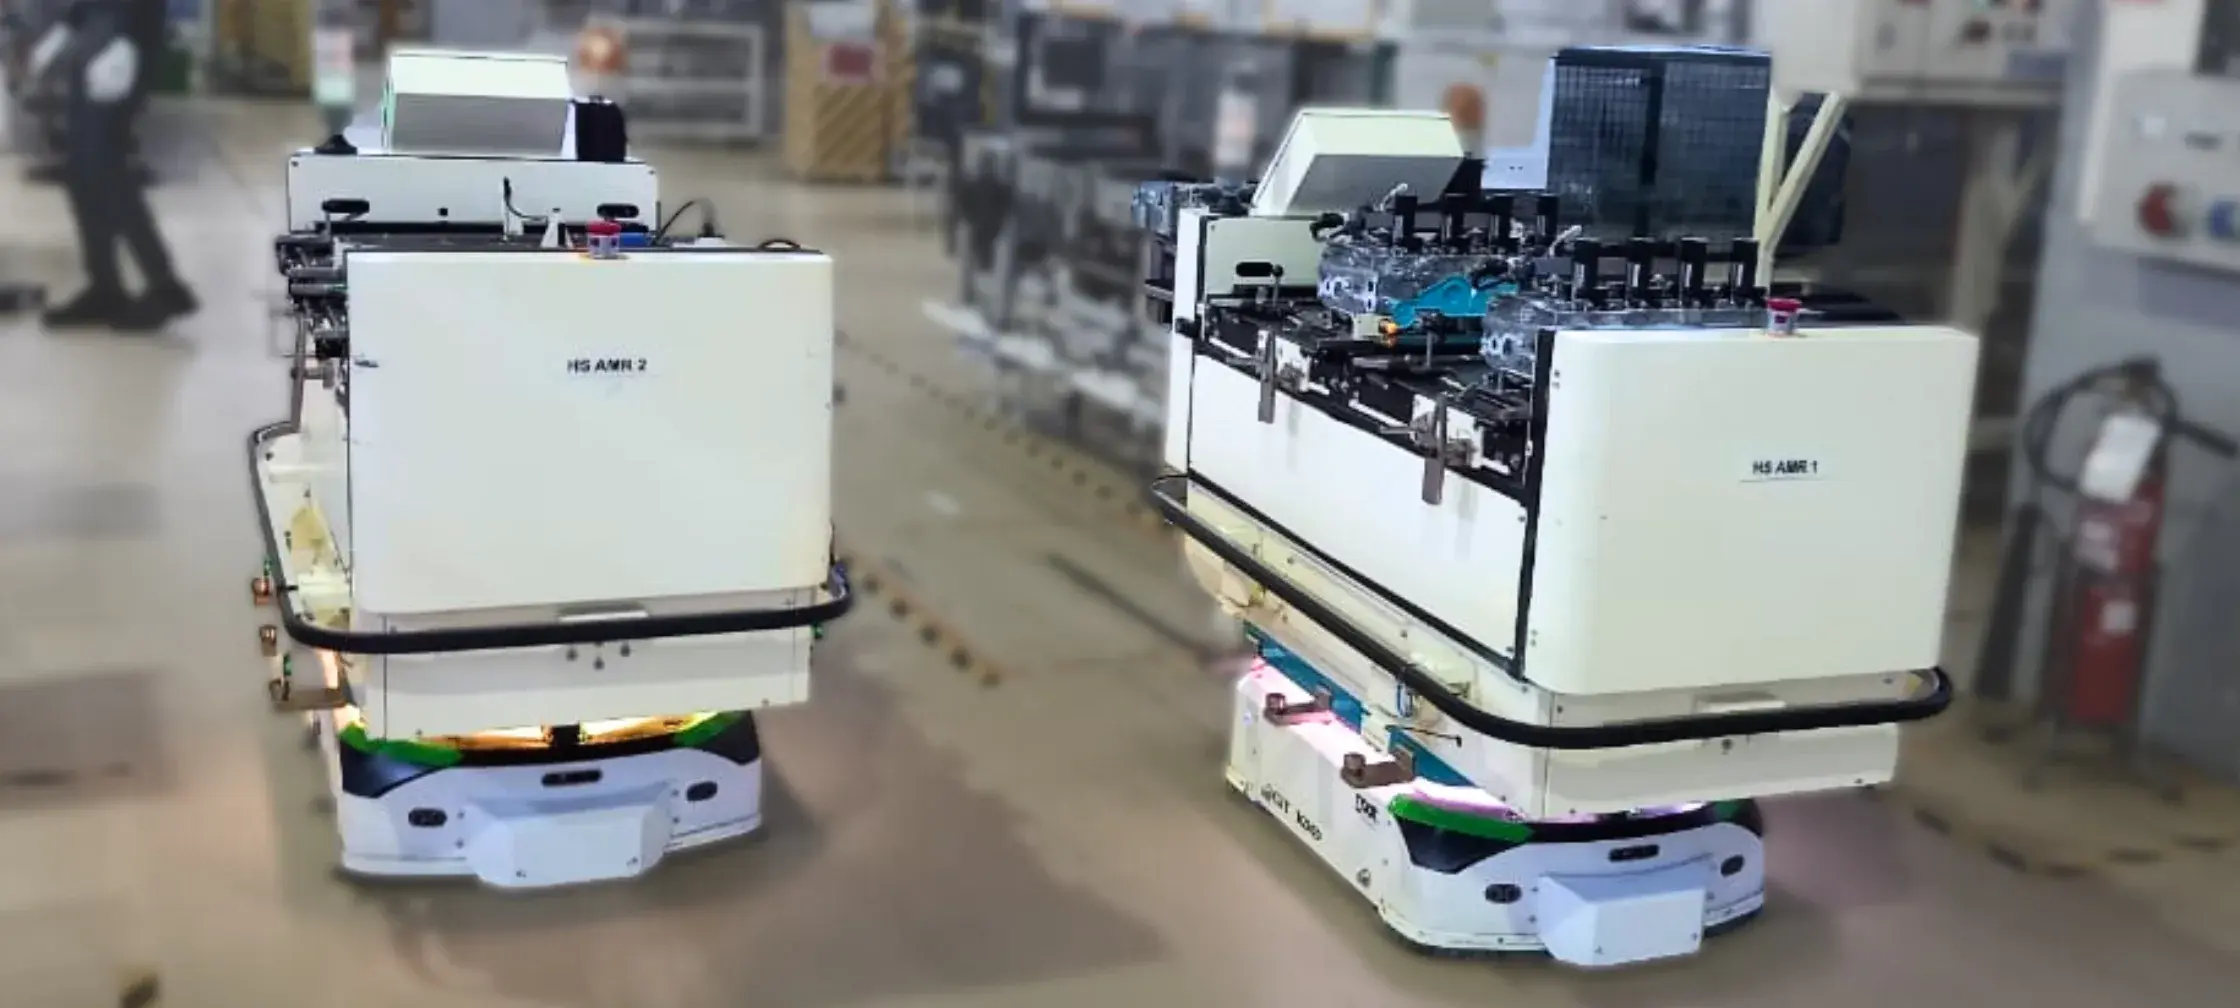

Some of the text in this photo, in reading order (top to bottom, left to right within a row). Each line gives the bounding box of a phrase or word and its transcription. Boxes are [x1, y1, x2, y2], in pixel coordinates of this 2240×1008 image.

[595, 358, 632, 373] AMR
[638, 358, 647, 371] 2
[1774, 459, 1808, 474] AMR
[1811, 460, 1818, 474] 1
